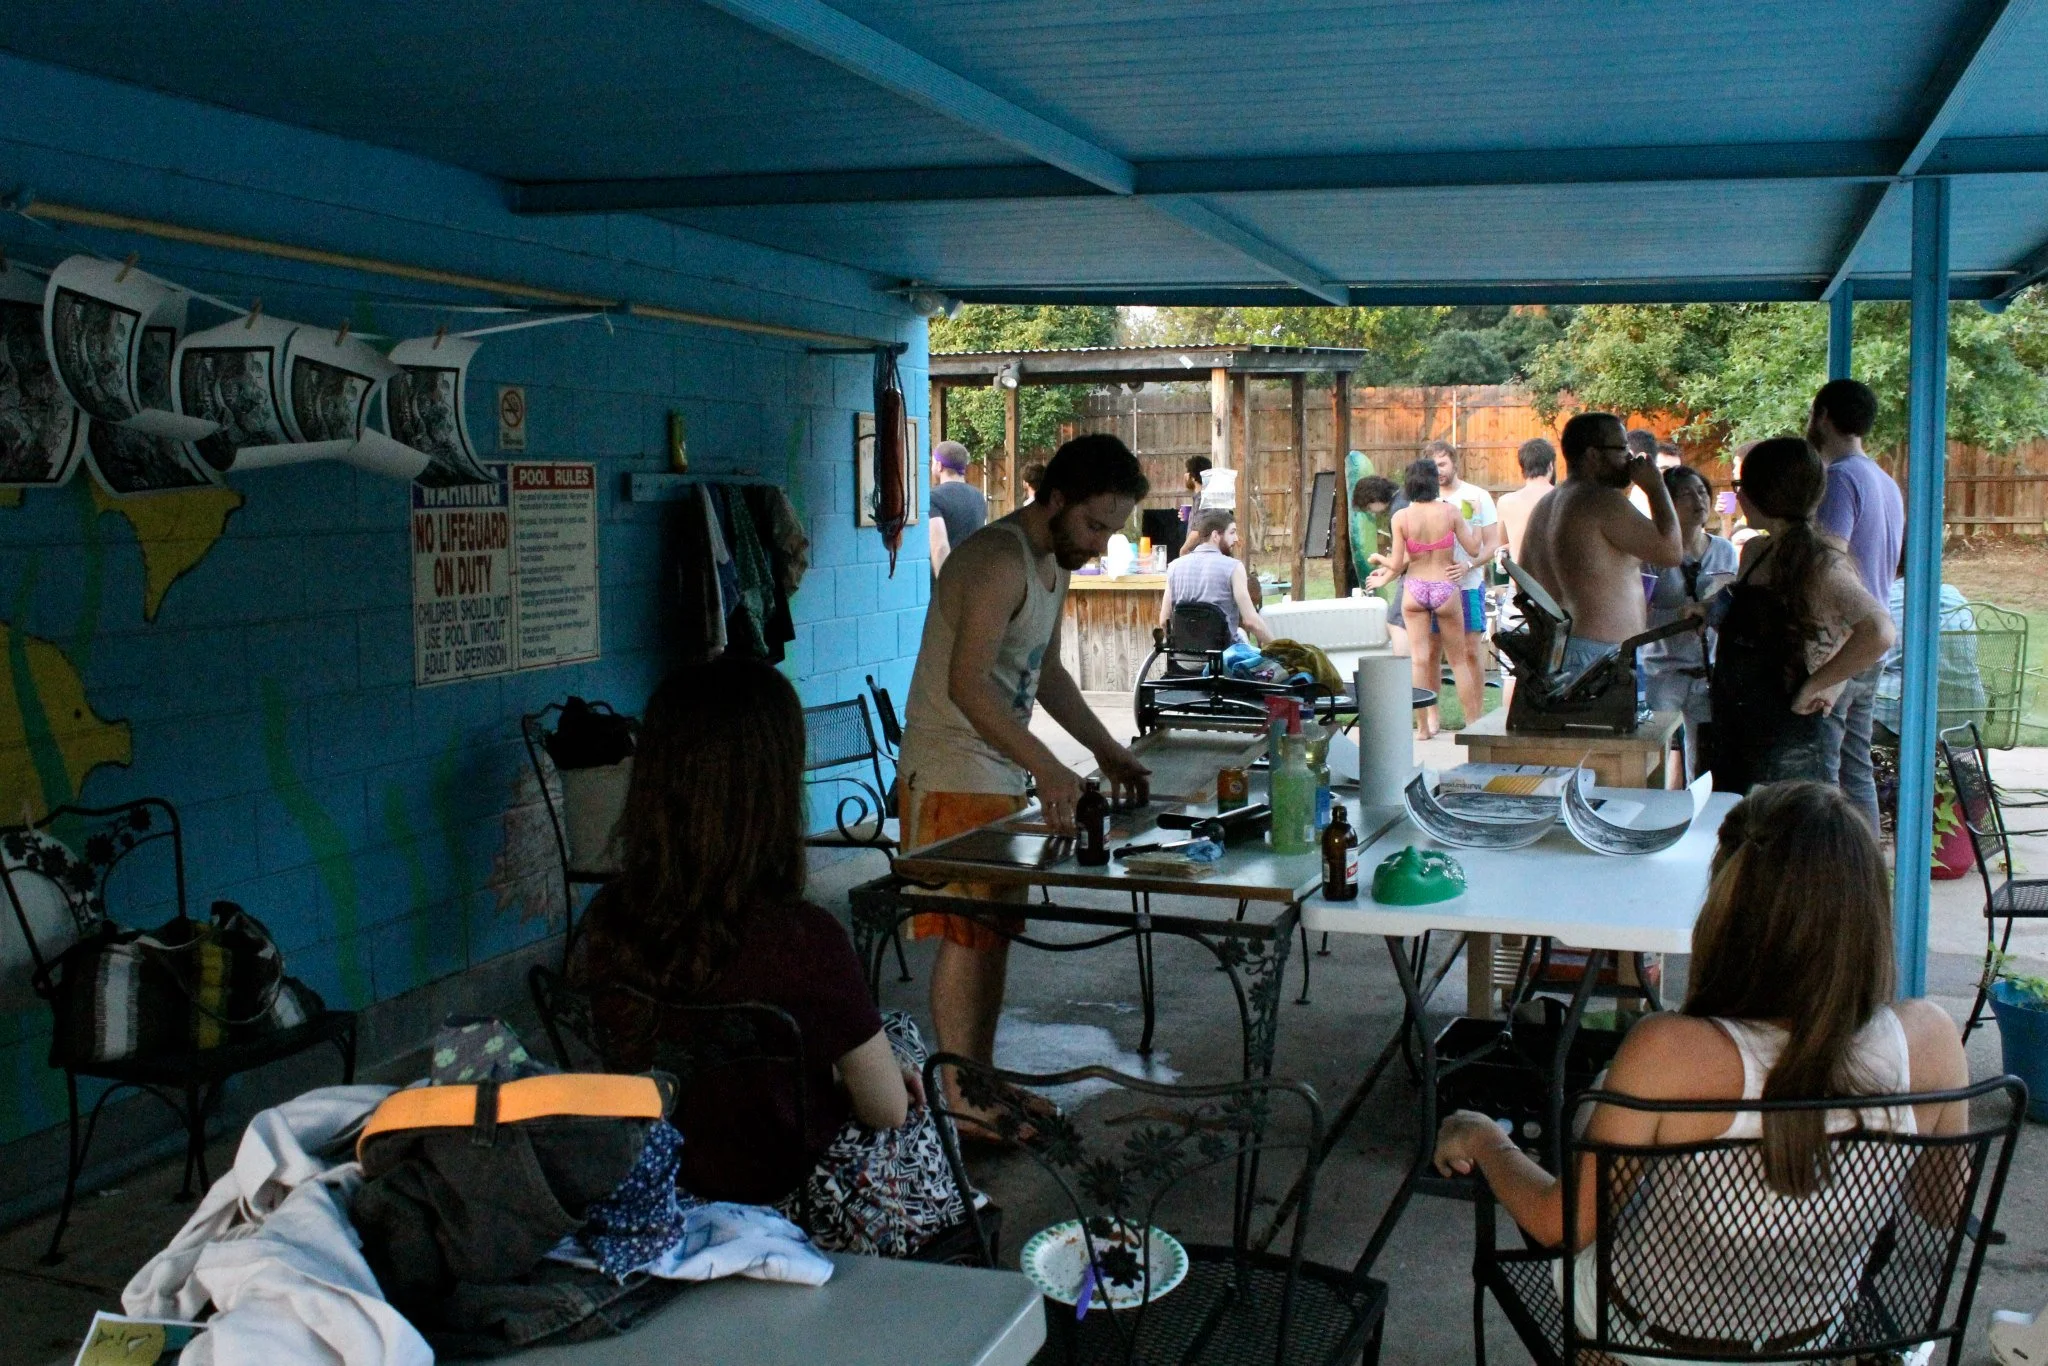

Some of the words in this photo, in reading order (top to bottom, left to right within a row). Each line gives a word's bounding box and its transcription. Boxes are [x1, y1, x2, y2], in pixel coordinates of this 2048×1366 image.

[519, 469, 550, 486] POOL
[554, 468, 589, 485] RULES
[415, 513, 434, 553] NO
[439, 511, 507, 552] LIFEGUARD
[434, 556, 453, 597] ON
[457, 554, 492, 595] DUTY
[418, 600, 458, 625] CHILDREN
[460, 597, 491, 621] SHOULD
[494, 595, 510, 617] NOT
[424, 626, 442, 650] USE
[445, 623, 468, 648] POOL
[470, 619, 506, 644] WITHOUT
[424, 650, 451, 676] ADULT
[455, 643, 507, 672] SUPERVISION
